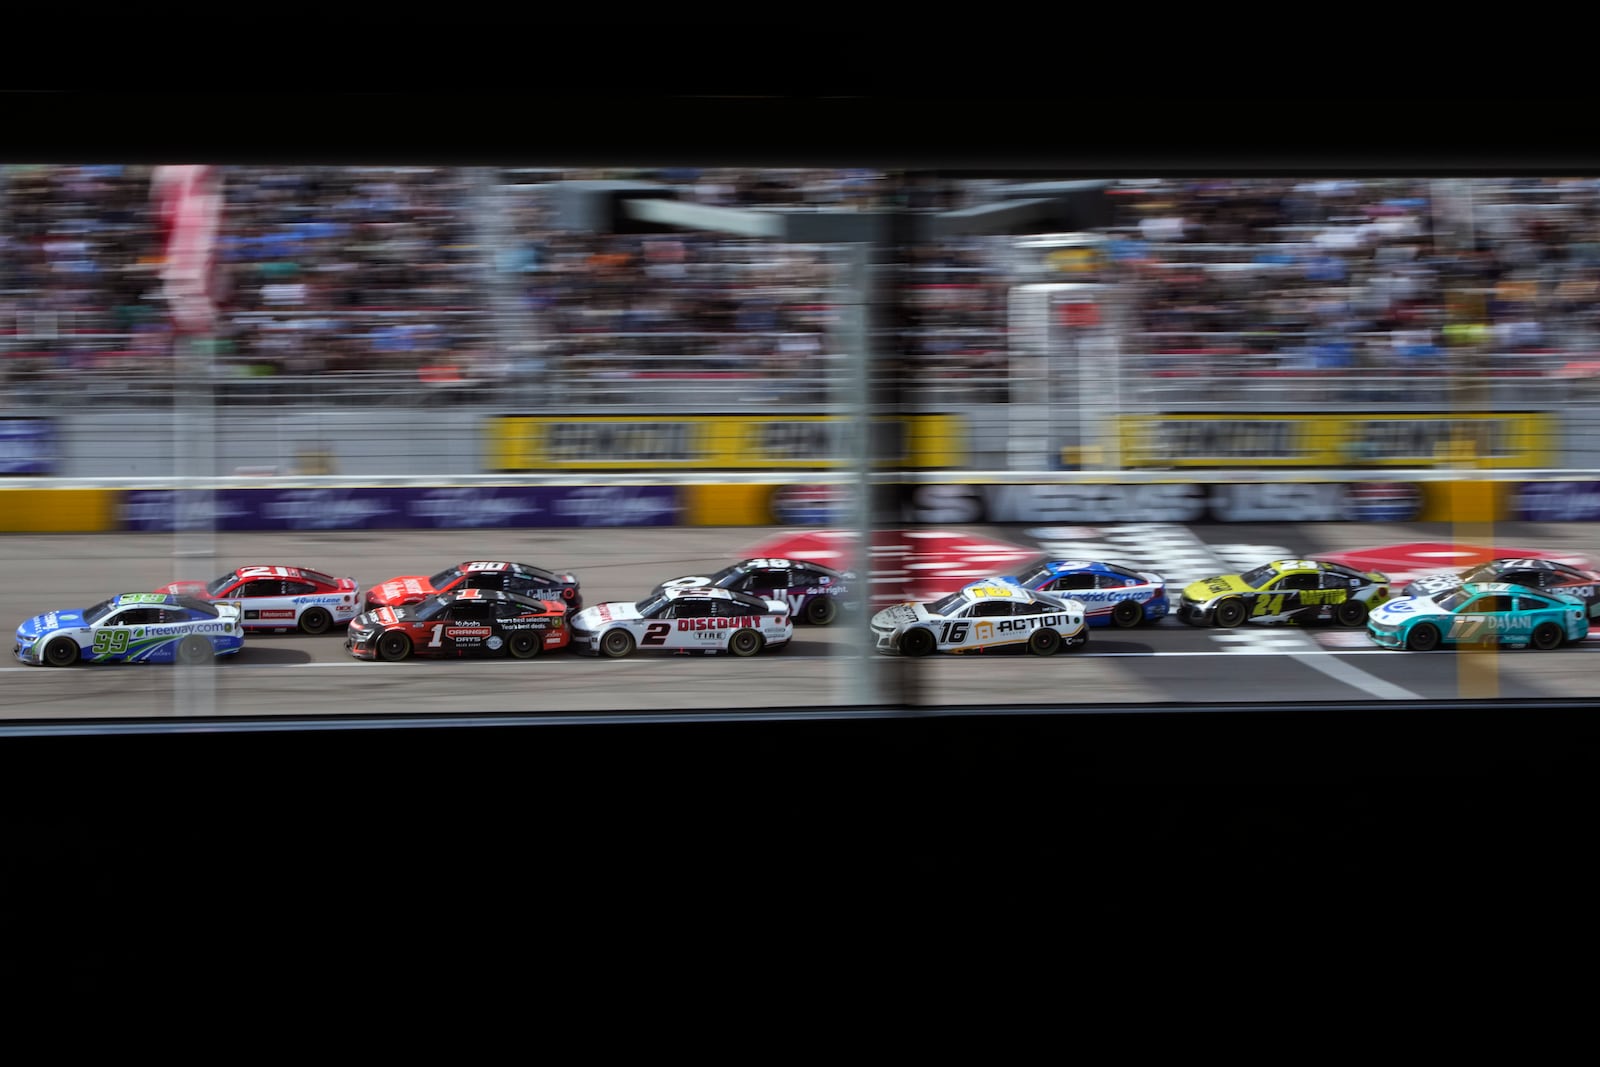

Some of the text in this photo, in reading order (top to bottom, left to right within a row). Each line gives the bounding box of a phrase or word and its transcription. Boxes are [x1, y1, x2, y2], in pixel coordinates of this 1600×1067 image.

[456, 588, 483, 600] 1
[806, 587, 818, 595] do
[826, 586, 848, 596] right.
[1252, 594, 1285, 616] 24
[144, 622, 223, 637] Freeway.com
[677, 615, 761, 632] DISCOUNT
[940, 621, 970, 644] 16
[997, 615, 1070, 633] ACTION
[1448, 616, 1486, 638] 17
[1488, 613, 1532, 632] DASANI
[92, 629, 129, 653] 99
[427, 624, 444, 648] 1
[640, 623, 672, 645] 2
